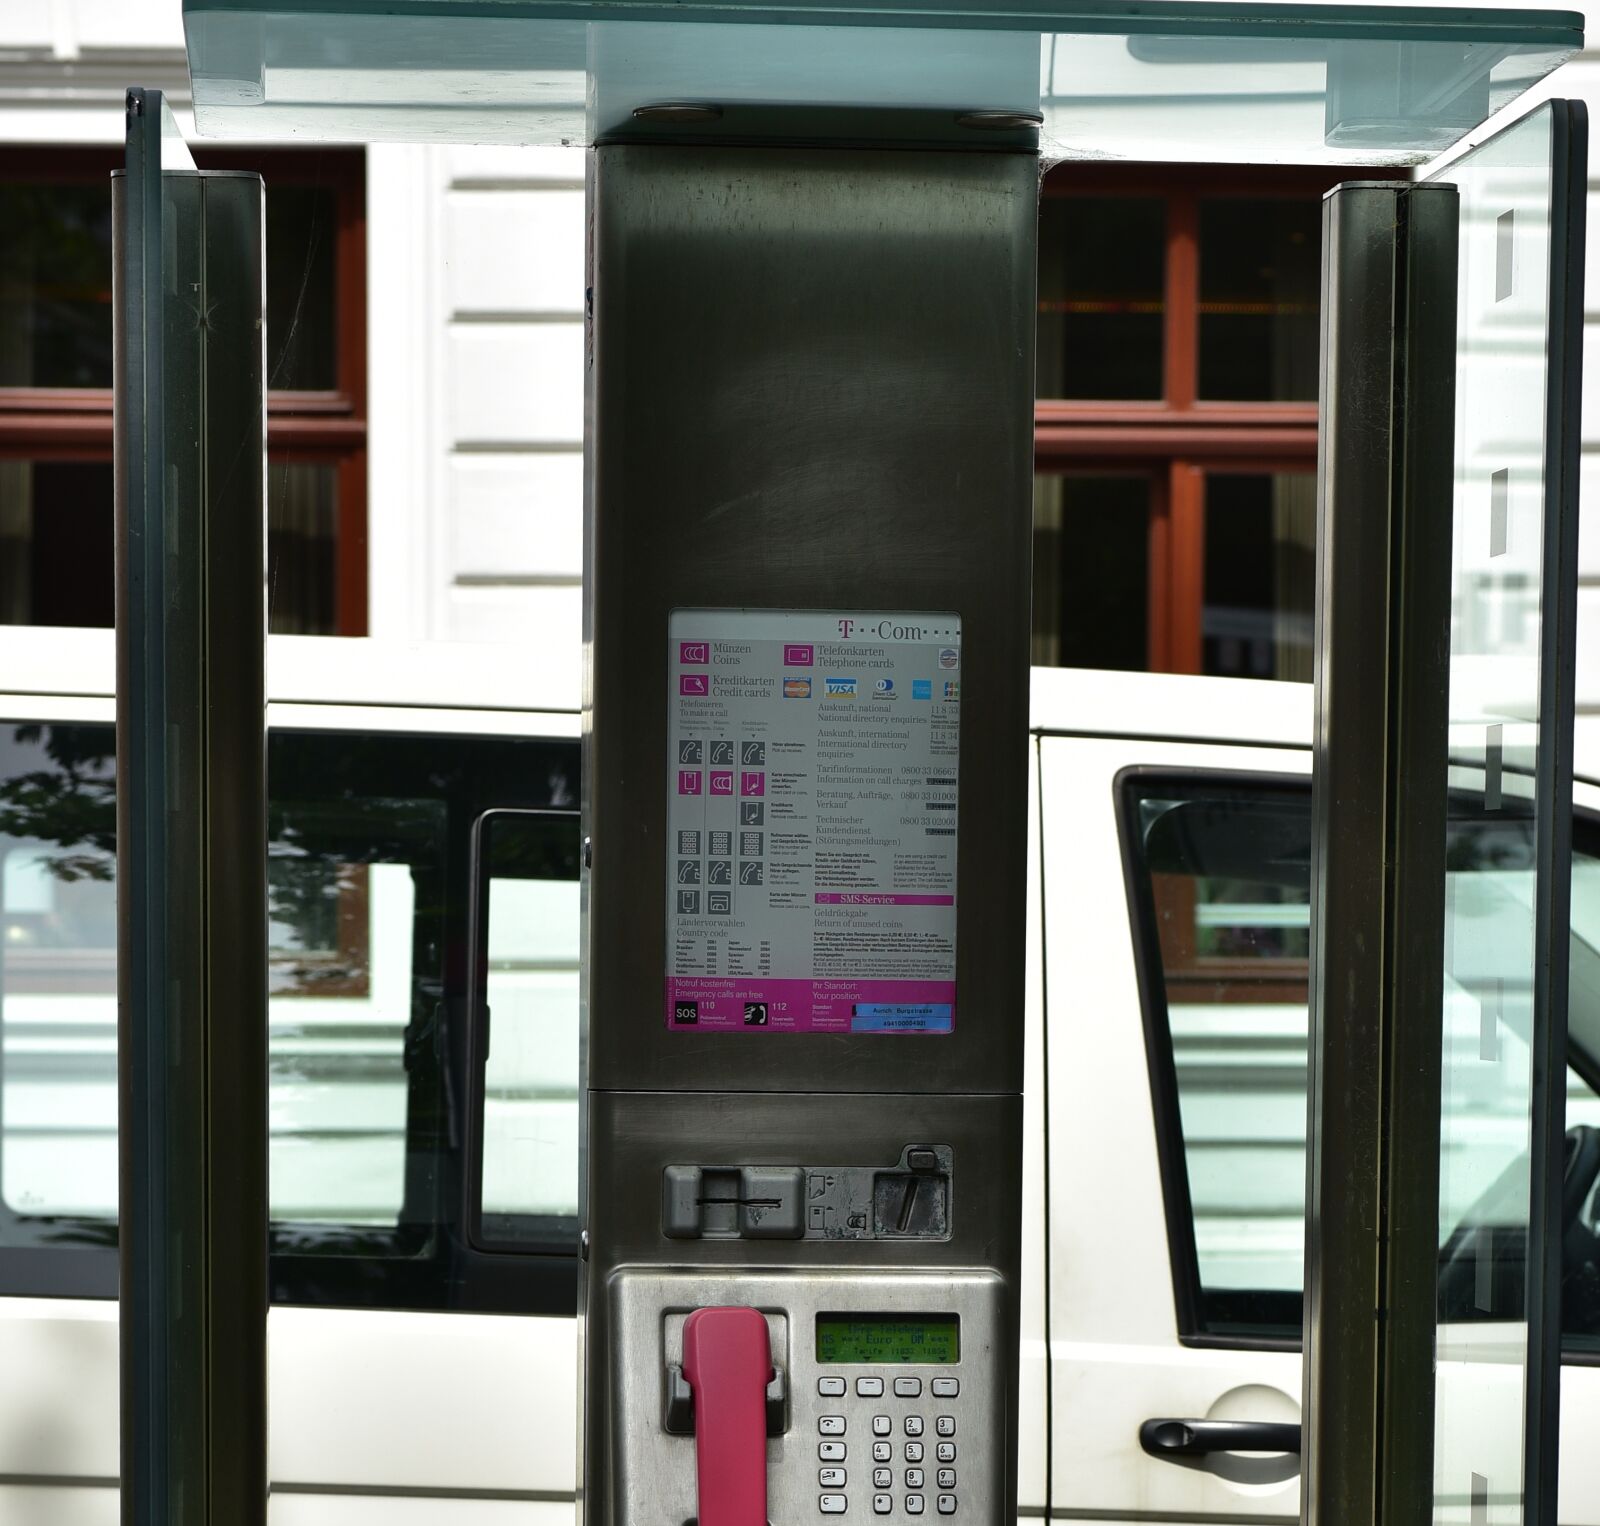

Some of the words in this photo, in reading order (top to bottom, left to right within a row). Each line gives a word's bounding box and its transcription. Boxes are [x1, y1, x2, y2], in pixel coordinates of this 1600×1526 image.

[878, 620, 922, 641] Com
[713, 643, 752, 654] Münzen
[818, 645, 885, 657] Telefonkarten
[713, 655, 741, 665] Coins
[818, 657, 867, 670] Telephone
[868, 659, 895, 669] cards
[713, 675, 775, 687] Kreditkarten
[713, 687, 743, 697] Credit
[745, 688, 771, 698] cards
[829, 684, 854, 694] VISA
[680, 700, 724, 708] Telefonieren
[818, 704, 857, 713] Auskunft,
[859, 704, 891, 713] national
[680, 709, 689, 717] To
[689, 709, 710, 717] make
[716, 709, 728, 717] call
[818, 713, 852, 722] National
[853, 714, 889, 724] directory
[891, 716, 927, 725] enquiries
[818, 729, 857, 739] Auskunft,
[858, 730, 910, 739] international
[818, 739, 870, 748] International
[871, 740, 908, 751] directory
[817, 750, 854, 759] enquiries
[817, 763, 893, 774] Tarifinformationen
[817, 774, 865, 784] Information
[878, 775, 891, 785] call
[892, 776, 921, 787] charges
[817, 790, 855, 801] Beratung,
[857, 790, 894, 801] Aufträge,
[901, 791, 920, 800] 0800
[921, 791, 931, 800] 33
[817, 800, 848, 809] Verkauf
[816, 814, 865, 824] Technischer
[900, 816, 920, 825] 0800
[921, 817, 931, 825] 33
[816, 826, 871, 835] Kundendienst
[815, 836, 901, 847] (Störungsmeldungen)
[840, 894, 895, 905] SMS-Service
[814, 908, 868, 918] Geldrückgabe
[677, 918, 746, 928] Ländervorwahlen
[814, 919, 842, 928] Return
[843, 919, 852, 928] of
[853, 920, 881, 929] unused
[882, 921, 903, 929] coins
[677, 929, 709, 938] Country
[710, 930, 729, 938] code
[675, 978, 698, 988] Notruf
[700, 979, 736, 988] kostenfrei
[812, 981, 822, 990] Ihr
[824, 982, 858, 990] Standort:
[675, 989, 716, 999] Emergency
[717, 990, 734, 999] calls
[735, 991, 748, 999] are
[749, 990, 764, 999] free
[812, 992, 829, 1000] Your
[830, 992, 863, 1001] position:
[701, 1001, 715, 1010] 110
[773, 1003, 787, 1011] 112
[676, 1008, 697, 1018] SOS
[866, 1334, 893, 1345] Euro
[876, 1419, 880, 1427] 1
[908, 1419, 914, 1428] 2
[940, 1419, 946, 1428] 3
[875, 1445, 882, 1454] 4
[908, 1445, 914, 1454] 5
[940, 1445, 946, 1454] 6
[876, 1471, 882, 1480] 7
[909, 1471, 915, 1480] 8
[940, 1471, 946, 1480] 9
[823, 1497, 830, 1505] C
[909, 1498, 915, 1506] 0
